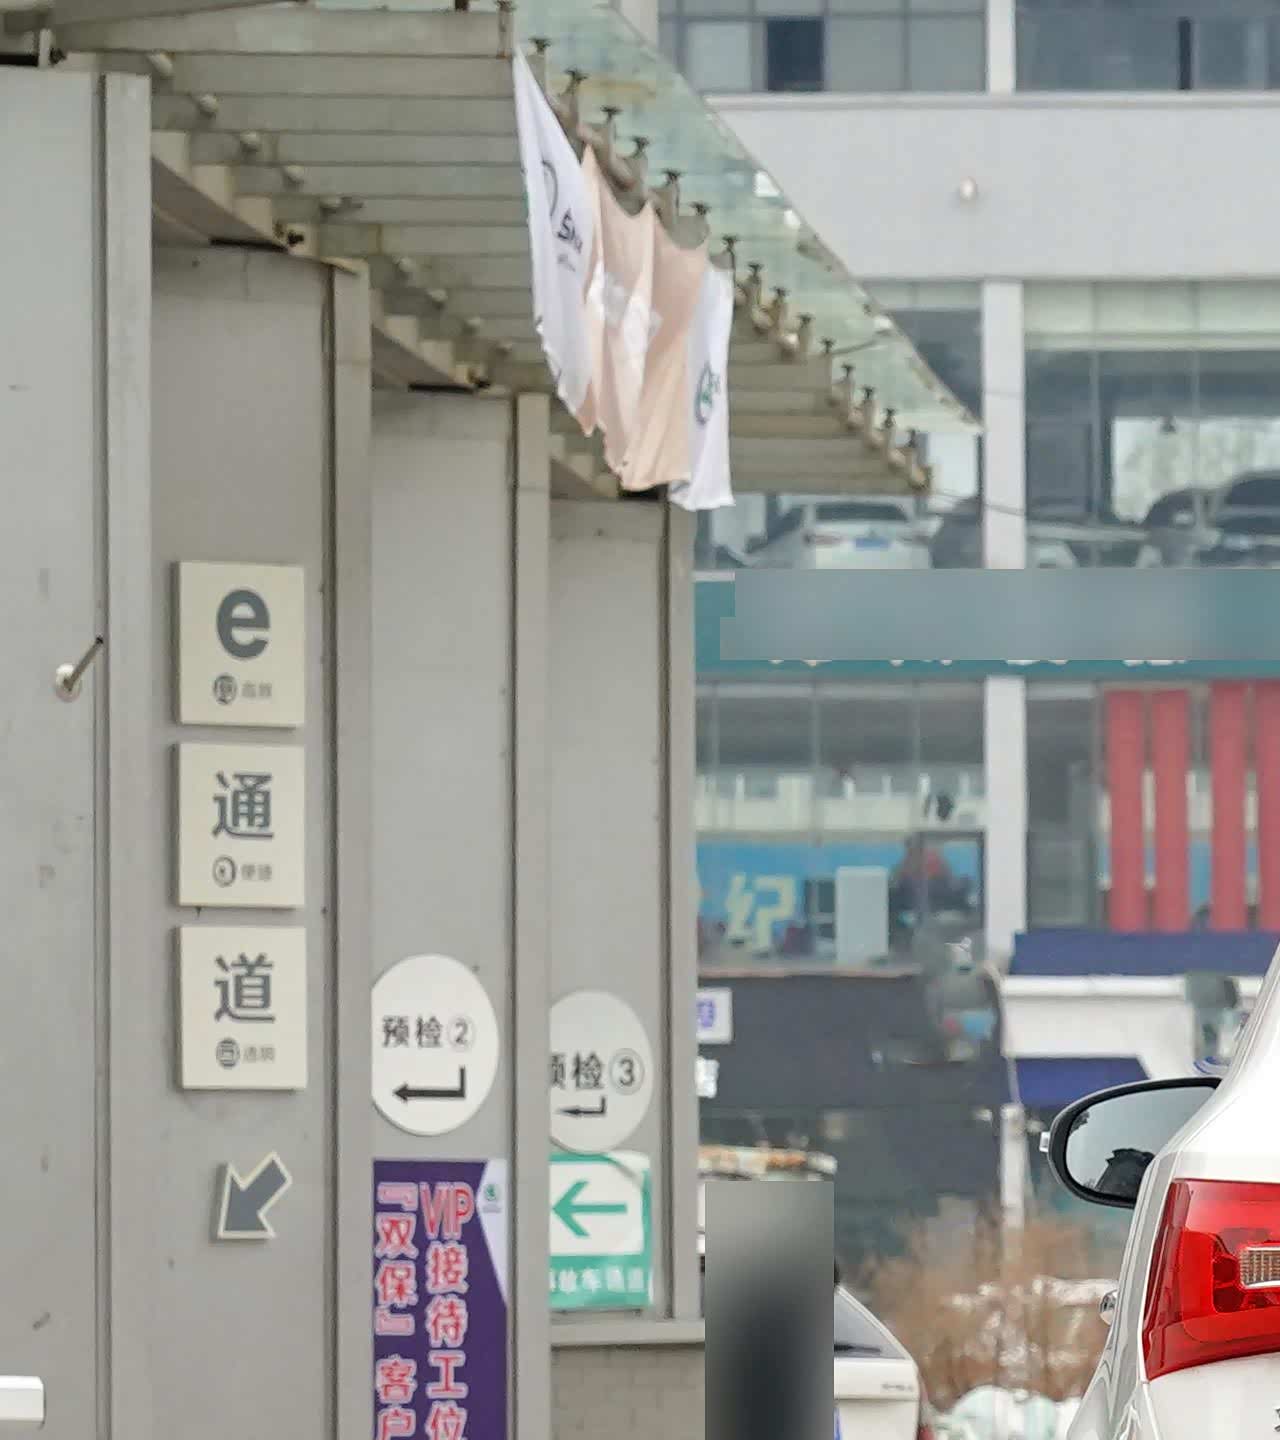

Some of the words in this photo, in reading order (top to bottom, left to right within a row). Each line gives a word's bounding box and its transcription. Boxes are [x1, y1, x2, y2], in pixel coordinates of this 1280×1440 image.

[216, 589, 271, 659] e
[212, 771, 274, 839] 通
[214, 953, 277, 1023] 道
